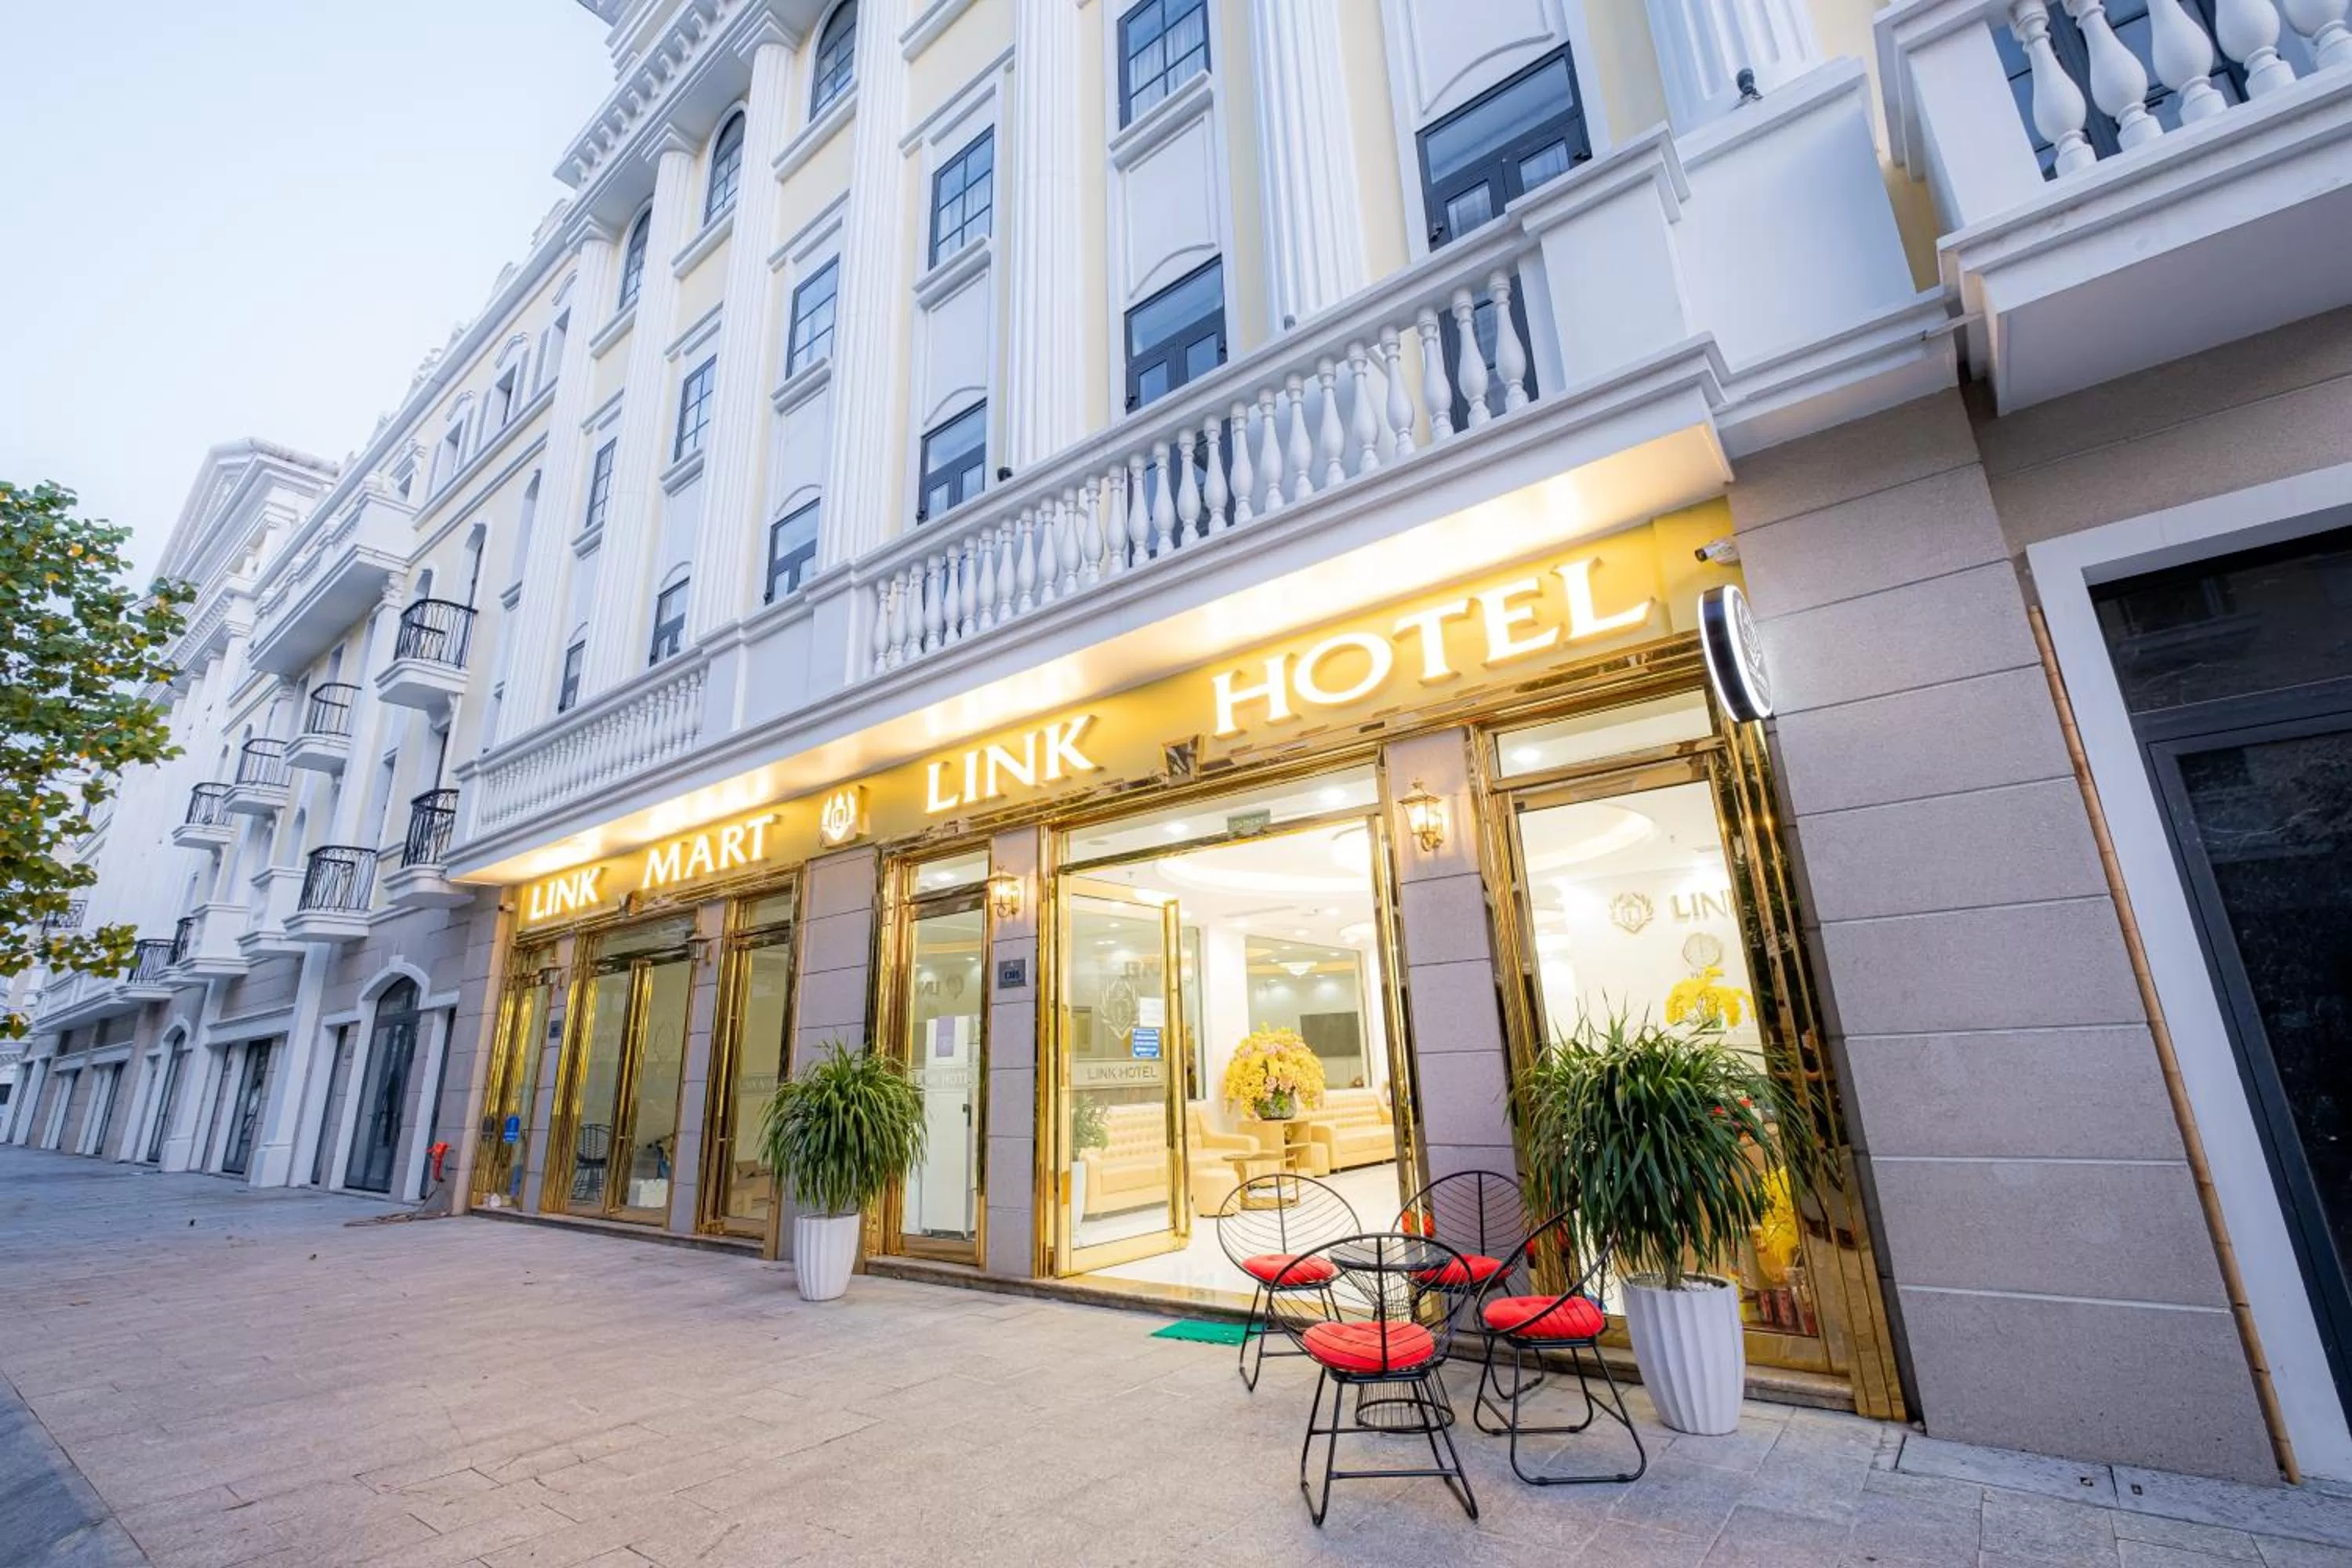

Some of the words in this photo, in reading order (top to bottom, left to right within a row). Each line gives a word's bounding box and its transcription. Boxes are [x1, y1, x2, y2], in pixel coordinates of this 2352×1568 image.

[925, 714, 1097, 814] LINK
[1212, 556, 1652, 736] HOTEL
[529, 866, 603, 920] LINK
[641, 813, 776, 890] MART
[1087, 1066, 1117, 1080] LINK
[1118, 1065, 1159, 1079] HOTEL
